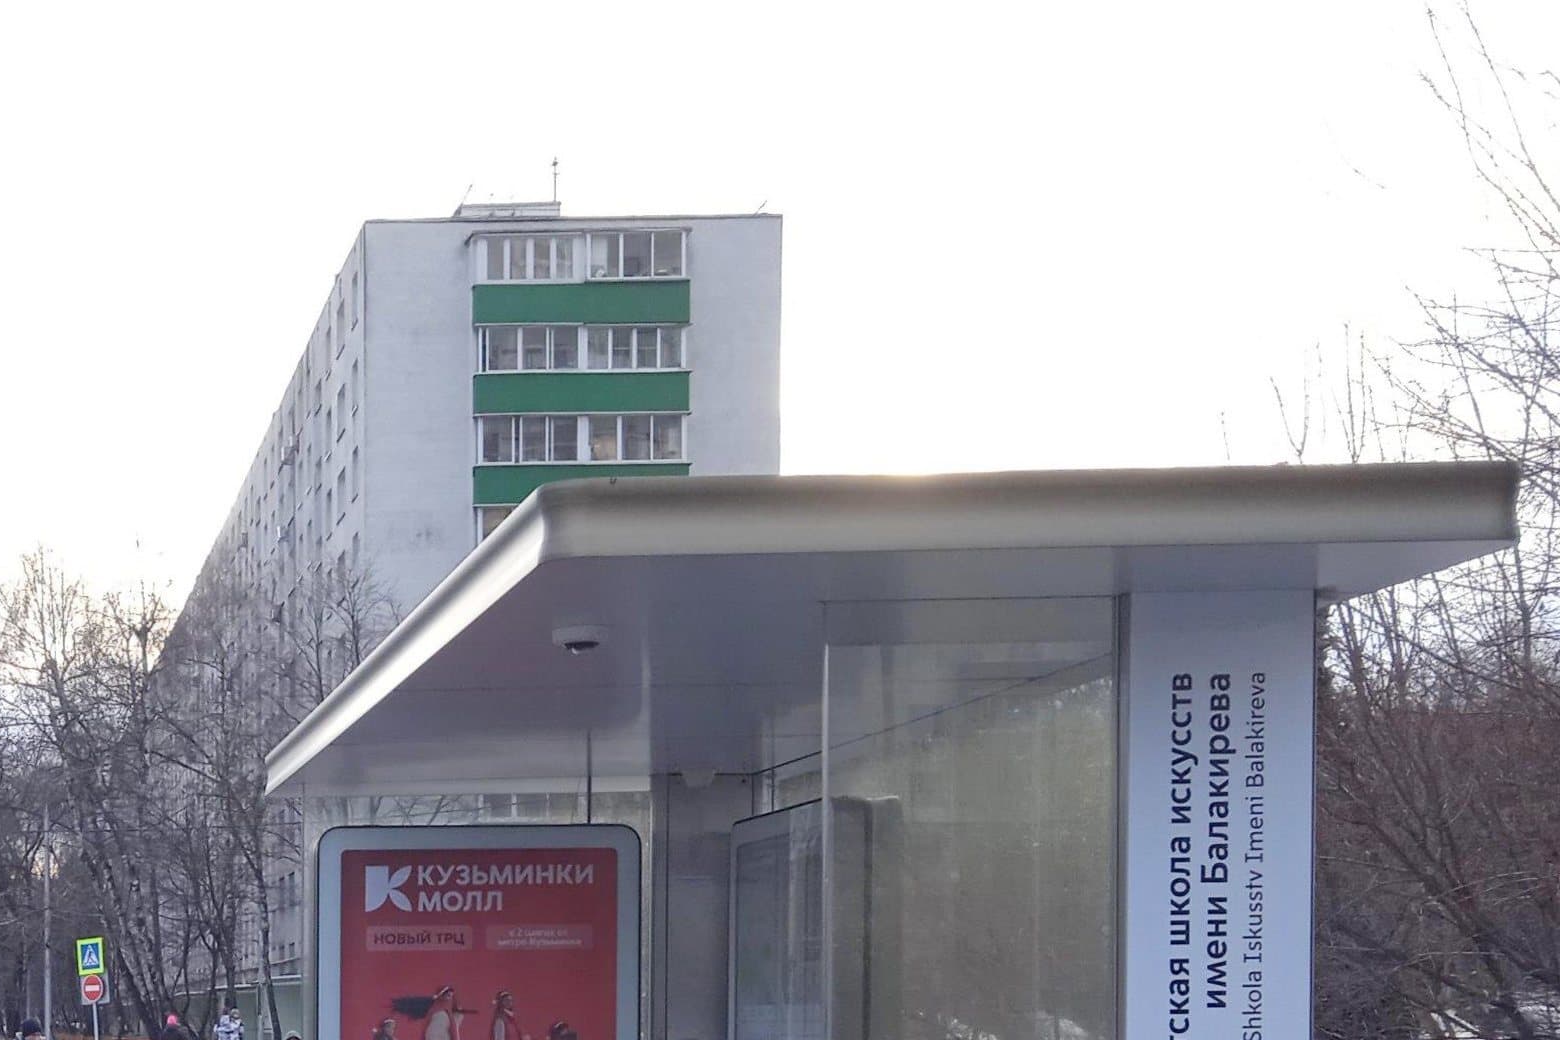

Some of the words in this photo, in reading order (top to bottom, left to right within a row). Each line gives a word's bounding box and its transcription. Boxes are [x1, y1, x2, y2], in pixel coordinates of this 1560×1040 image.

[1170, 672, 1199, 825] искусств
[1200, 672, 1237, 884] Балакирева
[1244, 671, 1266, 788] Balakireva
[417, 864, 594, 886] КУЗЬМИНКИ
[1244, 796, 1265, 863] Imeni
[373, 930, 432, 945] НОВЫЙ
[436, 932, 465, 946] ТРЦ
[417, 890, 504, 912] МОЛЛ
[1170, 835, 1192, 947] школа
[1243, 869, 1264, 963] Iskusstv
[1206, 896, 1228, 1009] имени
